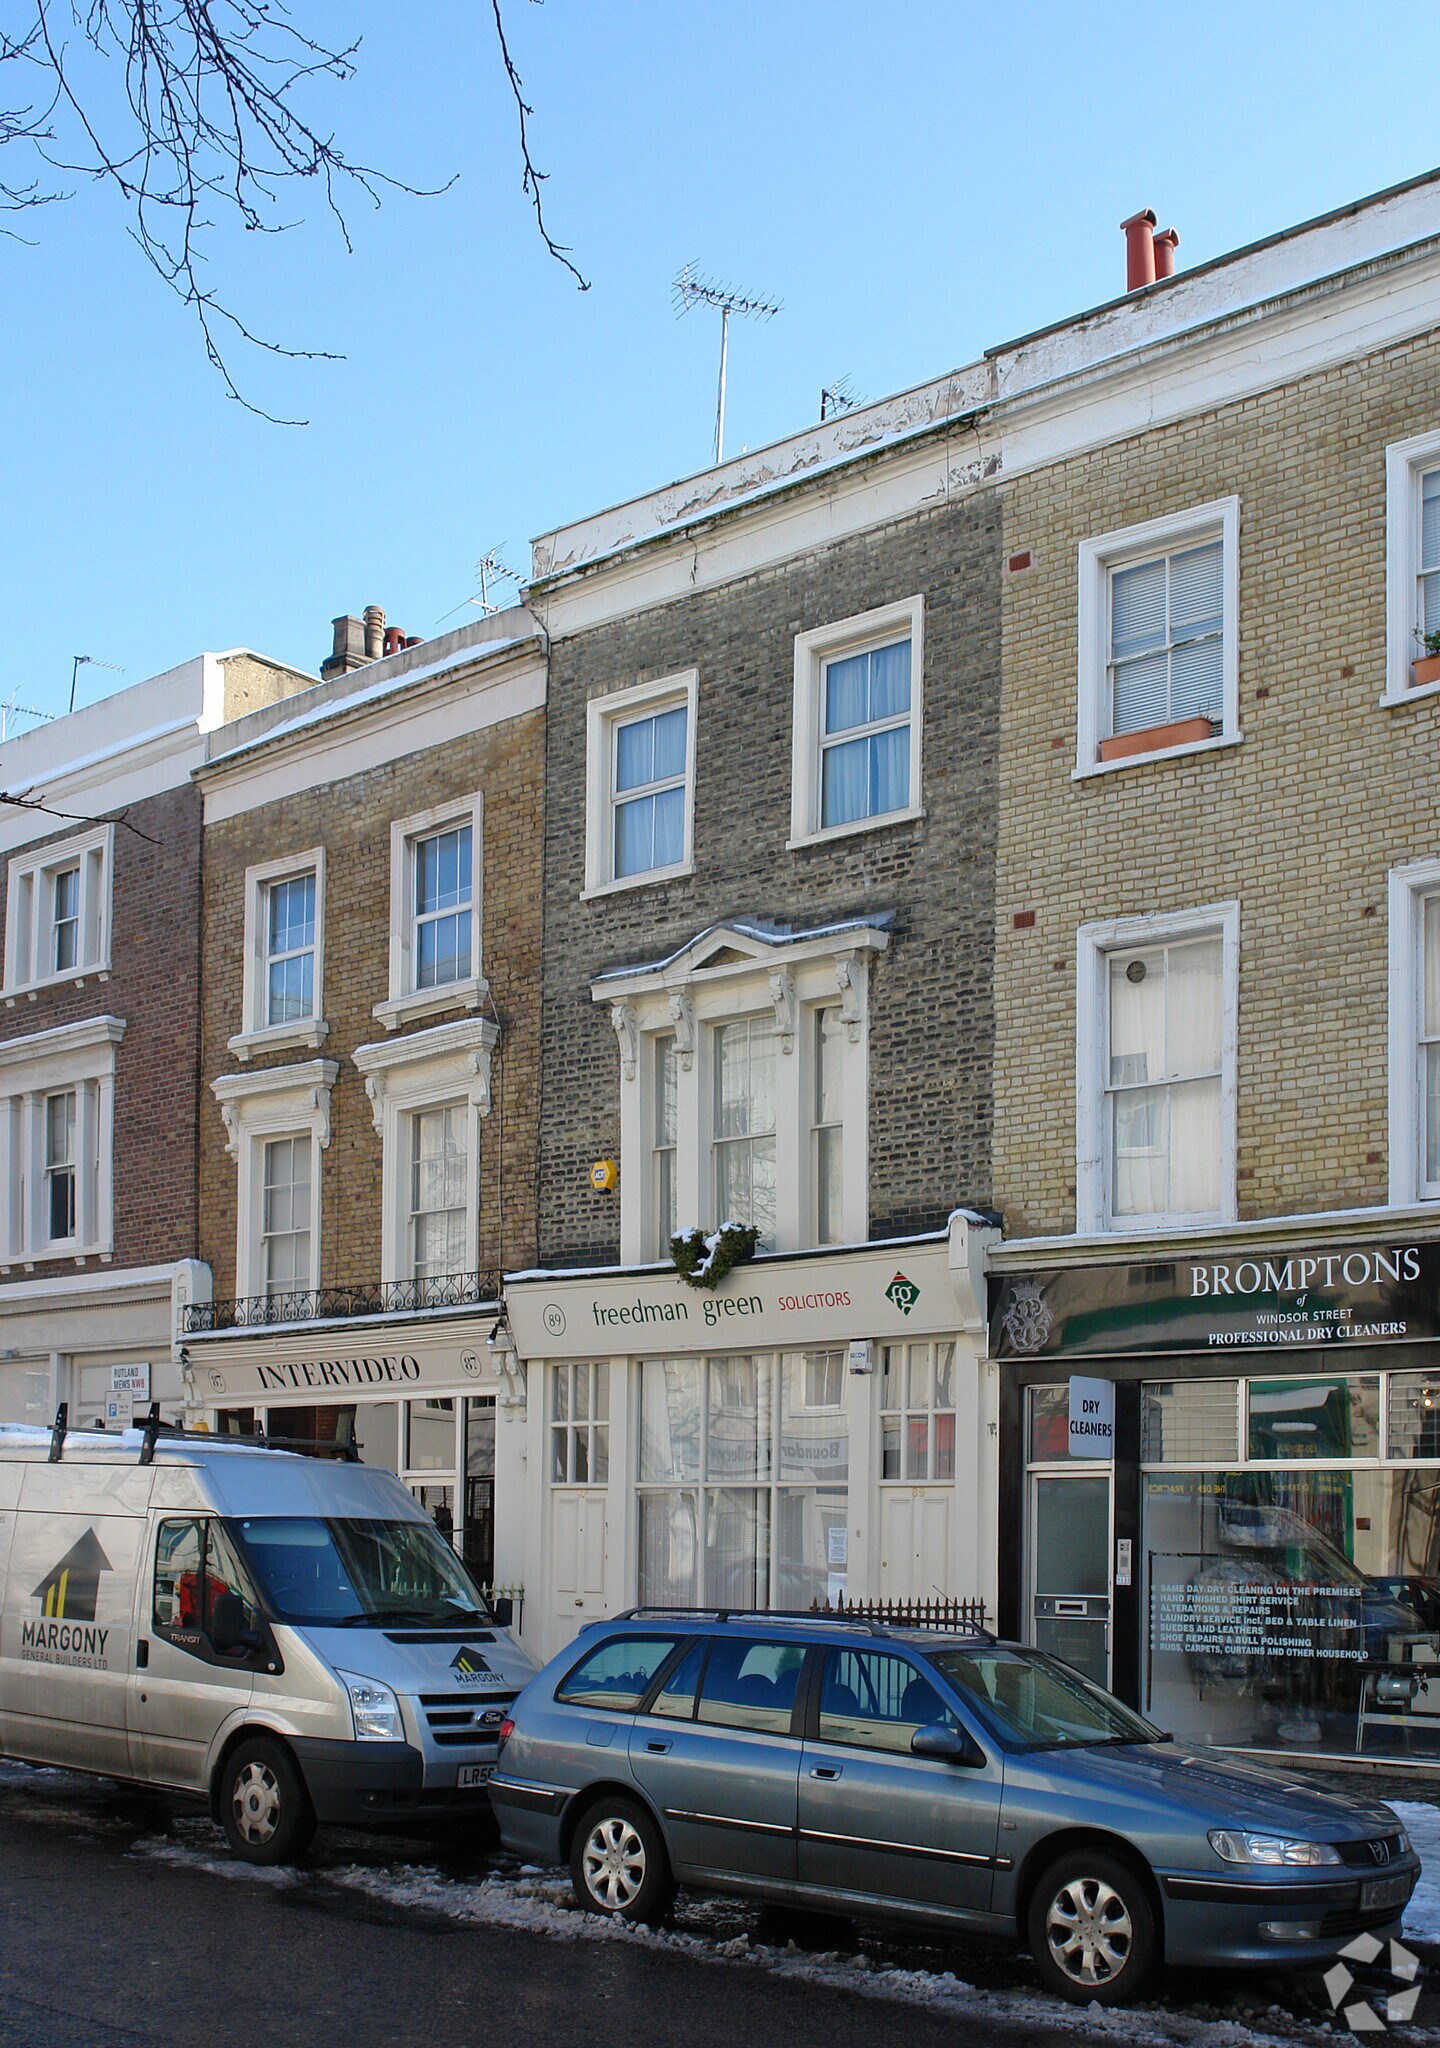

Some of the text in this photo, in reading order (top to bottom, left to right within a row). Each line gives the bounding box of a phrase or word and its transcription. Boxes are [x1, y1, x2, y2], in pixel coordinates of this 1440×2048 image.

[1190, 1247, 1421, 1297] BROMPTONS
[1296, 1294, 1307, 1307] of
[592, 1291, 852, 1326] freedman green SOLICITORS
[548, 1313, 561, 1327] 89
[1256, 1308, 1354, 1325] WINDSOR STREET
[1208, 1321, 1407, 1345] PROFESSIONAL DRY CLEANERS
[463, 1356, 478, 1371] 87
[113, 1367, 139, 1378] RUTLAND
[256, 1354, 420, 1390] INTERVIDEO
[113, 1379, 131, 1389] MEWS
[211, 1374, 223, 1387] 87
[1082, 1399, 1100, 1414] DRY
[1070, 1420, 1113, 1437] CLEANERS
[911, 1487, 926, 1498] 89
[1160, 1584, 1362, 1597] SAME DAY DRY CLEANING ON THE PREMISES
[1160, 1594, 1299, 1606] HAND FINISHED SHIRT SERVICE
[1160, 1604, 1271, 1615] ALTERATIONS & REPAIRS
[1160, 1614, 1201, 1623] LAUNDRY
[1203, 1615, 1242, 1624] SERVICE
[1265, 1616, 1284, 1626] BED
[1286, 1617, 1293, 1626] &
[1296, 1618, 1326, 1627] TABLE
[1328, 1618, 1357, 1627] LINEN
[1160, 1624, 1264, 1635] SUEDES AND LEATHERS
[22, 1620, 109, 1656] MARGONY
[170, 1632, 201, 1644] TRANSIT
[1160, 1633, 1312, 1647] SHOE REPAIRS & BULL POLISHING
[1160, 1643, 1369, 1659] RUGS, CARPETS, CURTAINS AND OTHER HOUSEHOLD
[21, 1650, 108, 1671] GENERAL BUILDERS LTD
[454, 1672, 506, 1684] MARGONY
